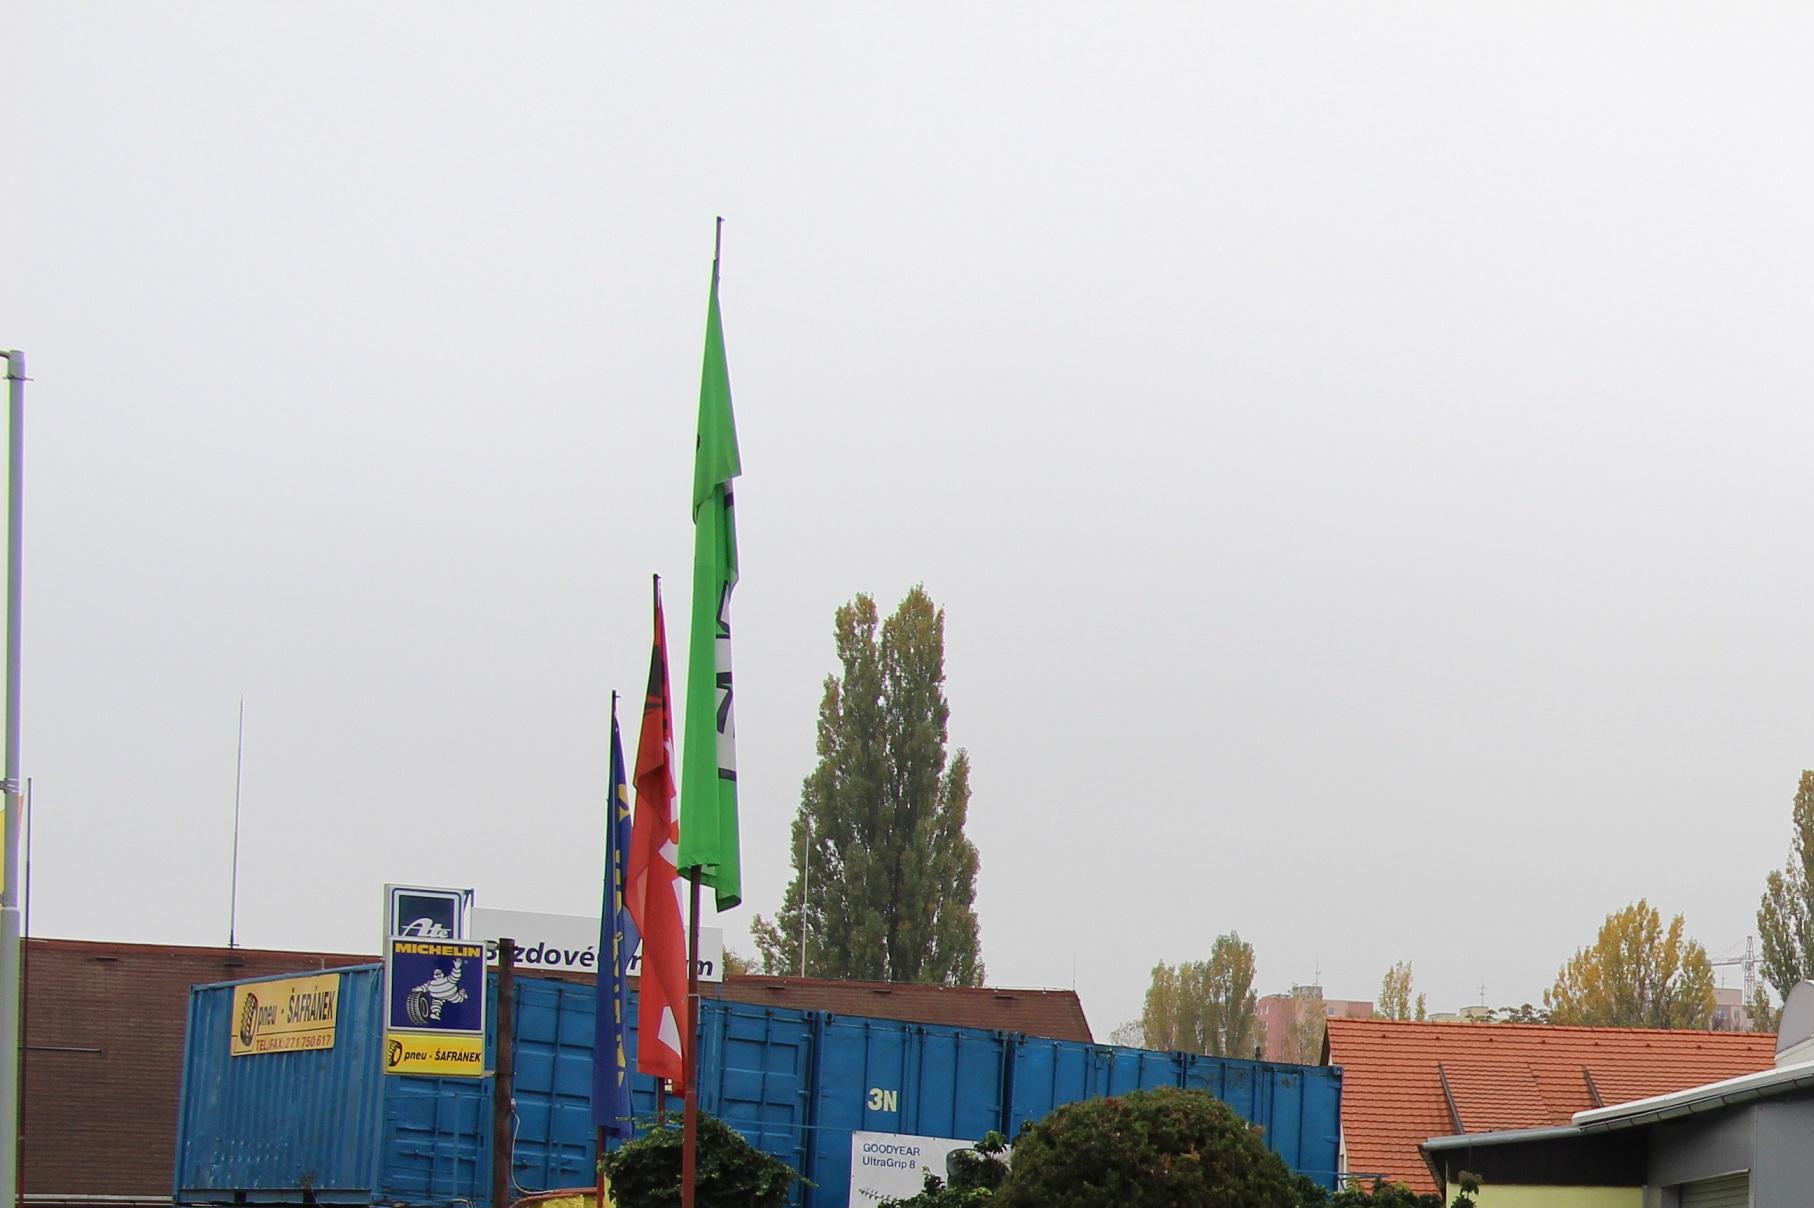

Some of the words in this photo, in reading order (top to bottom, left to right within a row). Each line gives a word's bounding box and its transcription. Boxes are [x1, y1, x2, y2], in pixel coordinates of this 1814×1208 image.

[402, 918, 451, 938] Ate
[396, 943, 480, 957] MICHELIN
[486, 940, 595, 967] Bzdové
[257, 1005, 277, 1032] pneu
[287, 986, 336, 1024] ŠAFRÁNEK
[302, 1035, 316, 1047] 750
[317, 1034, 331, 1046] 617
[404, 1052, 427, 1063] pneu
[435, 1048, 481, 1063] ŠAFRÁNEK
[867, 1087, 898, 1112] 3N
[863, 1143, 920, 1157] GOODYEAR
[862, 1156, 907, 1171] UltraGrip
[909, 1160, 916, 1169] 8
